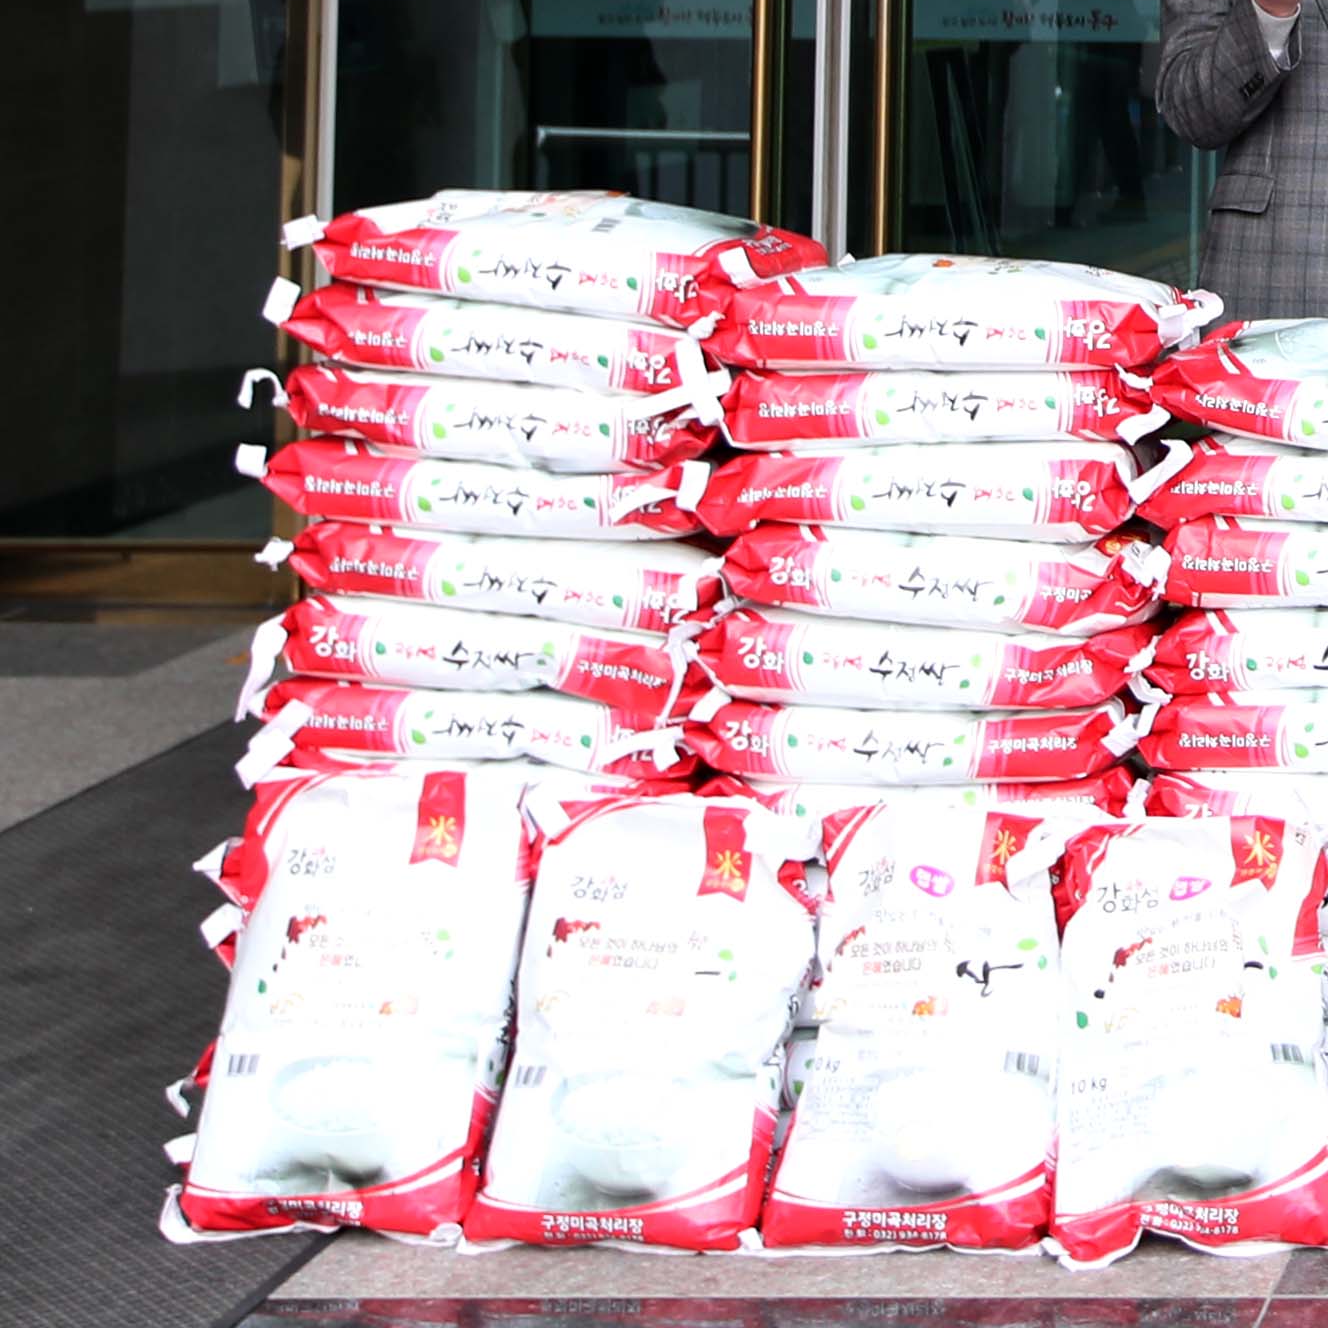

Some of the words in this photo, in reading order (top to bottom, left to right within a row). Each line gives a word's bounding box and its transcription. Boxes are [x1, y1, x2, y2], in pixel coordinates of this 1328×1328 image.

[737, 637, 785, 673] 강화
[1186, 652, 1232, 682] 강화
[725, 720, 770, 757] 강화
[428, 815, 458, 845] 米
[1243, 830, 1277, 866] 米
[1098, 885, 1160, 915] 강화섬
[540, 1213, 645, 1235] 구정미곡처리장
[842, 1210, 947, 1229] 구정미곡처리장
